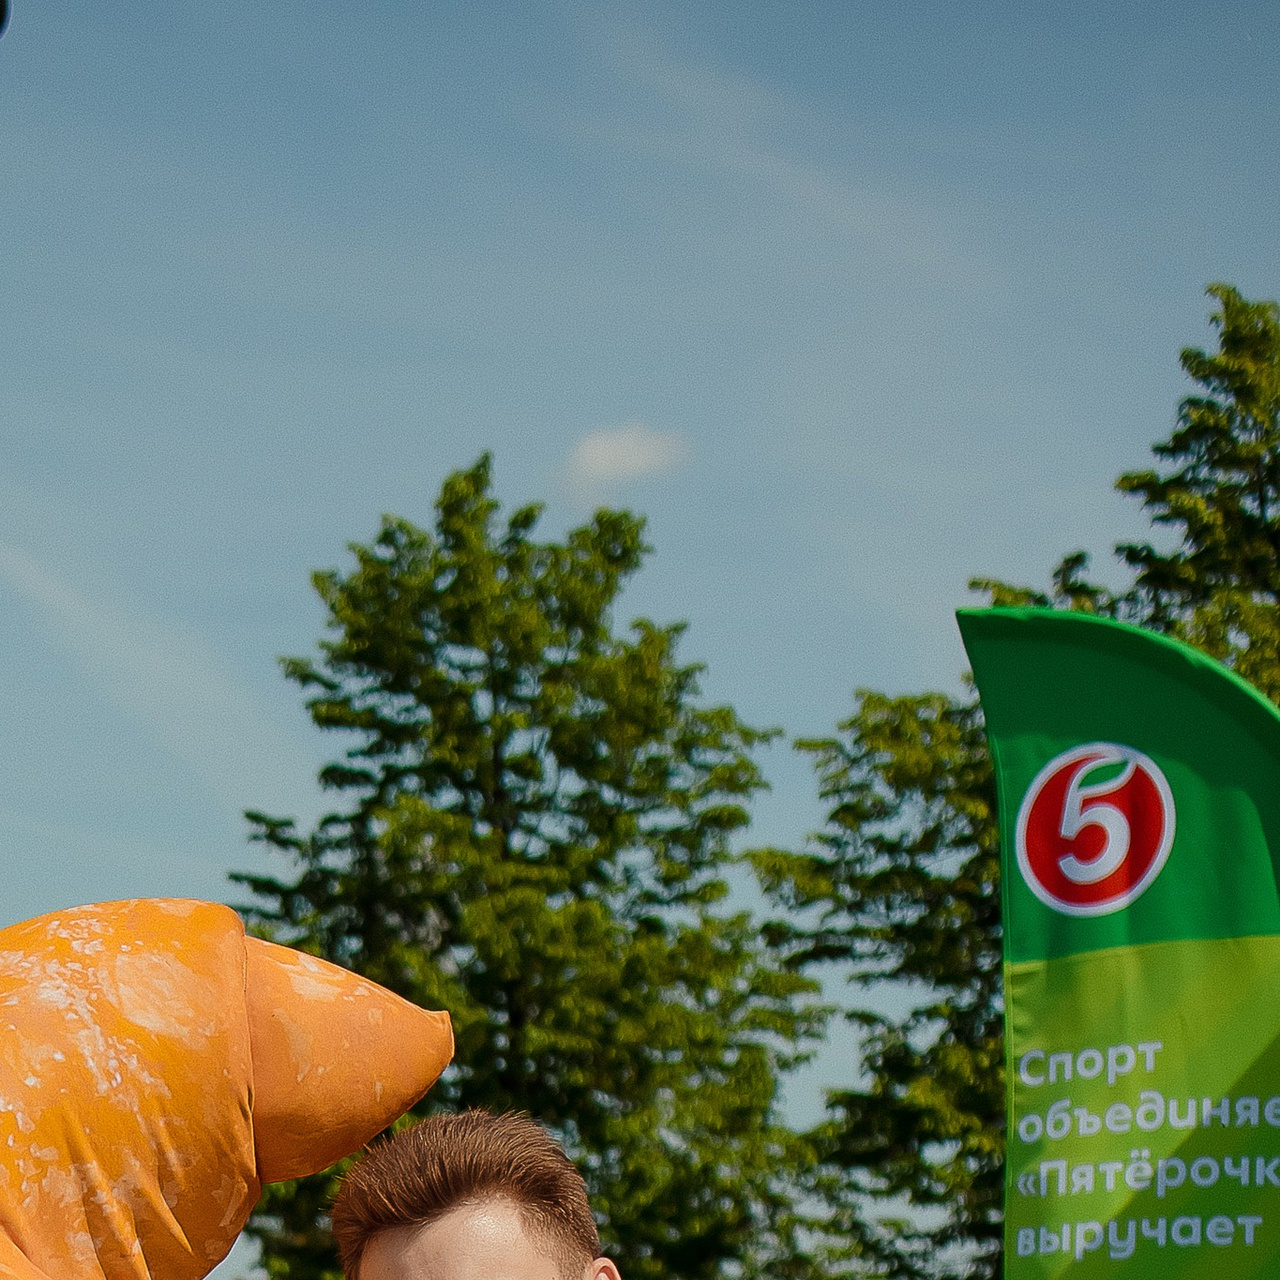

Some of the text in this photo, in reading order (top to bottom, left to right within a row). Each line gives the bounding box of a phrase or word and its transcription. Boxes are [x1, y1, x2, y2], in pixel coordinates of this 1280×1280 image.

[1057, 755, 1138, 886] 5
[1019, 1041, 1163, 1086] Спорт
[1018, 1214, 1263, 1260] выручает
